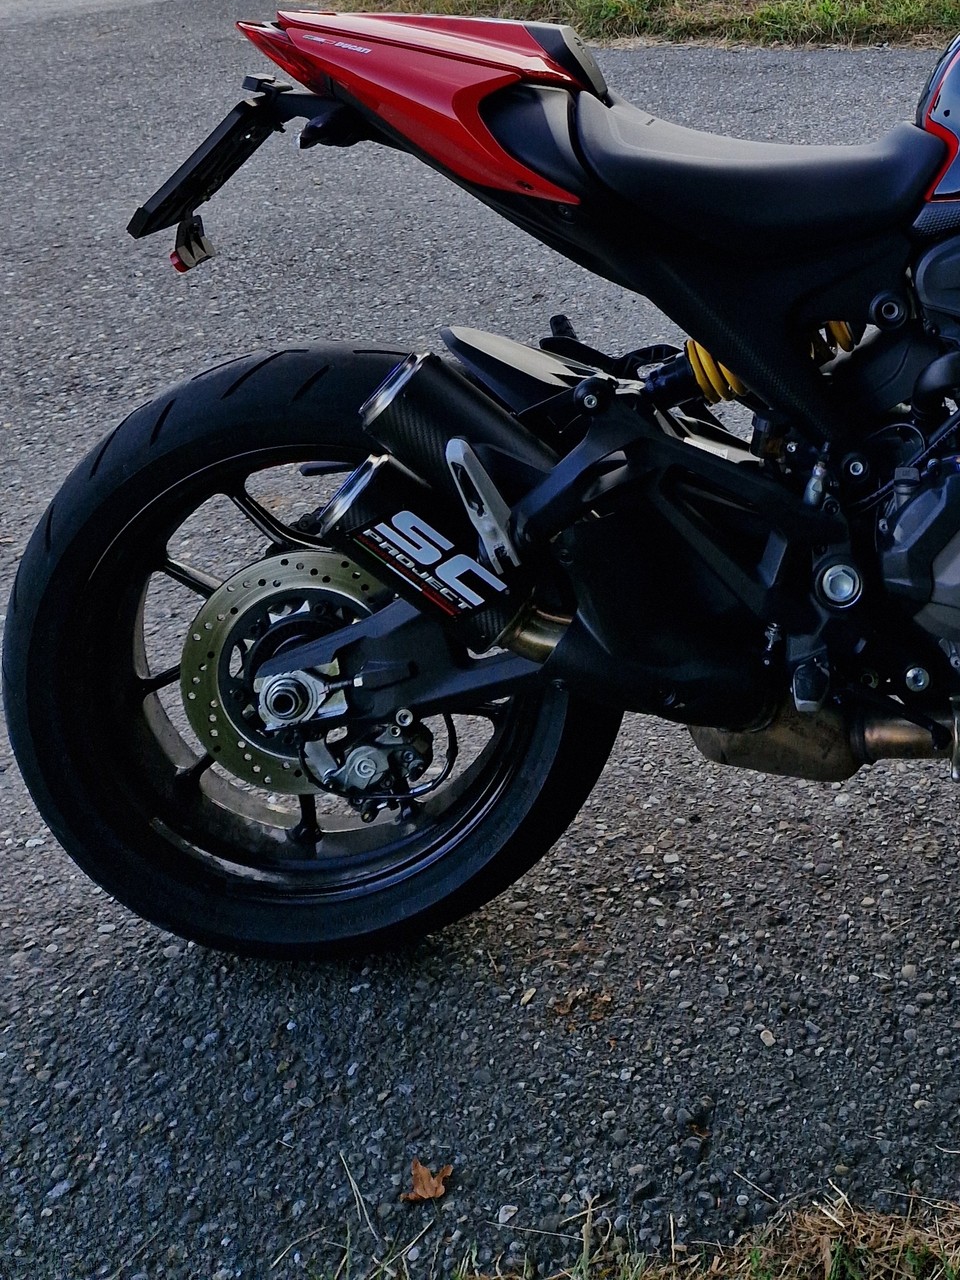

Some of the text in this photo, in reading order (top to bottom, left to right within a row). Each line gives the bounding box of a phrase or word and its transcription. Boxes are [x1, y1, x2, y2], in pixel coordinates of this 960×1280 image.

[334, 41, 372, 53] DUCATI
[362, 528, 473, 610] PROJECT
[374, 510, 508, 606] SC
